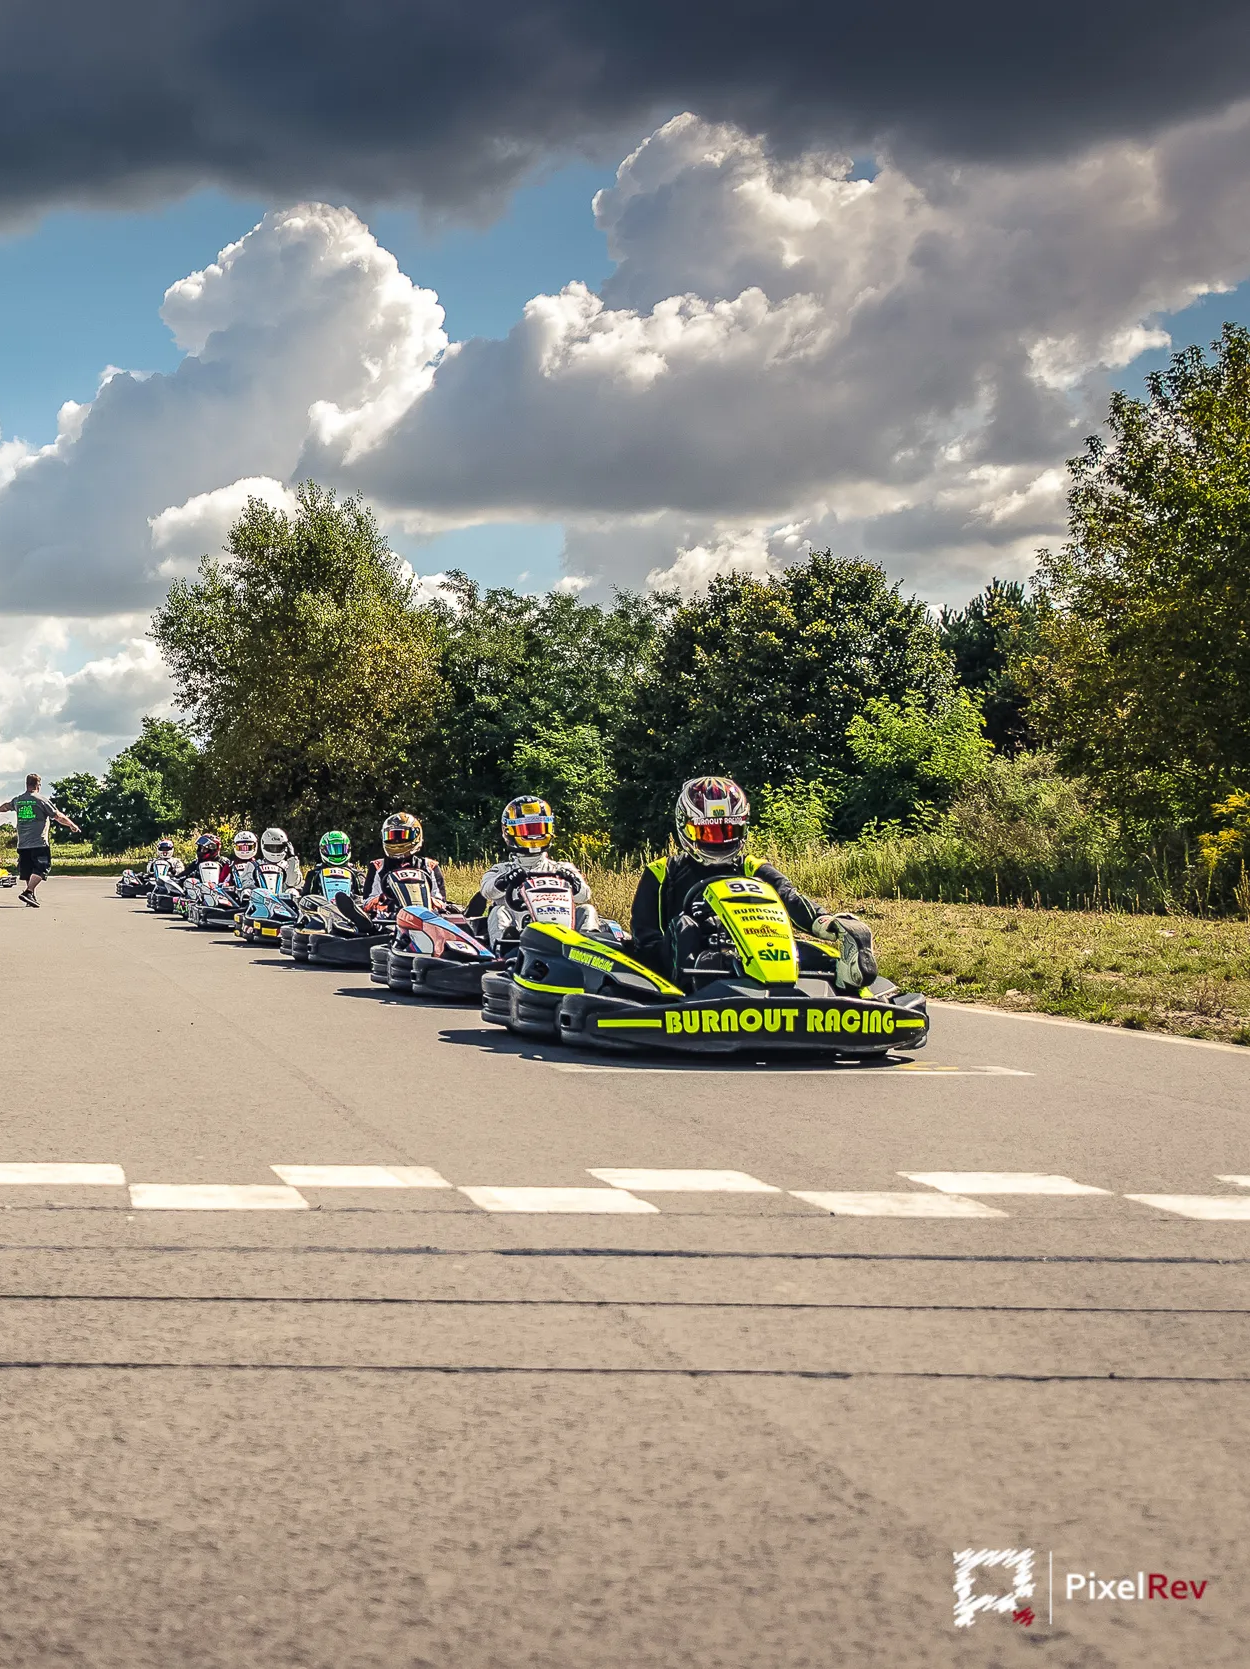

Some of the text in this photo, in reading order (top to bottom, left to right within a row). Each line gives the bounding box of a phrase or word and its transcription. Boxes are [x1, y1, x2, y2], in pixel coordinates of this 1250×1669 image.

[535, 879, 559, 887] 93
[728, 883, 763, 894] 92
[733, 907, 784, 915] BURNOUT
[741, 915, 784, 923] RACING
[665, 1008, 895, 1034] BURNOUT RACING
